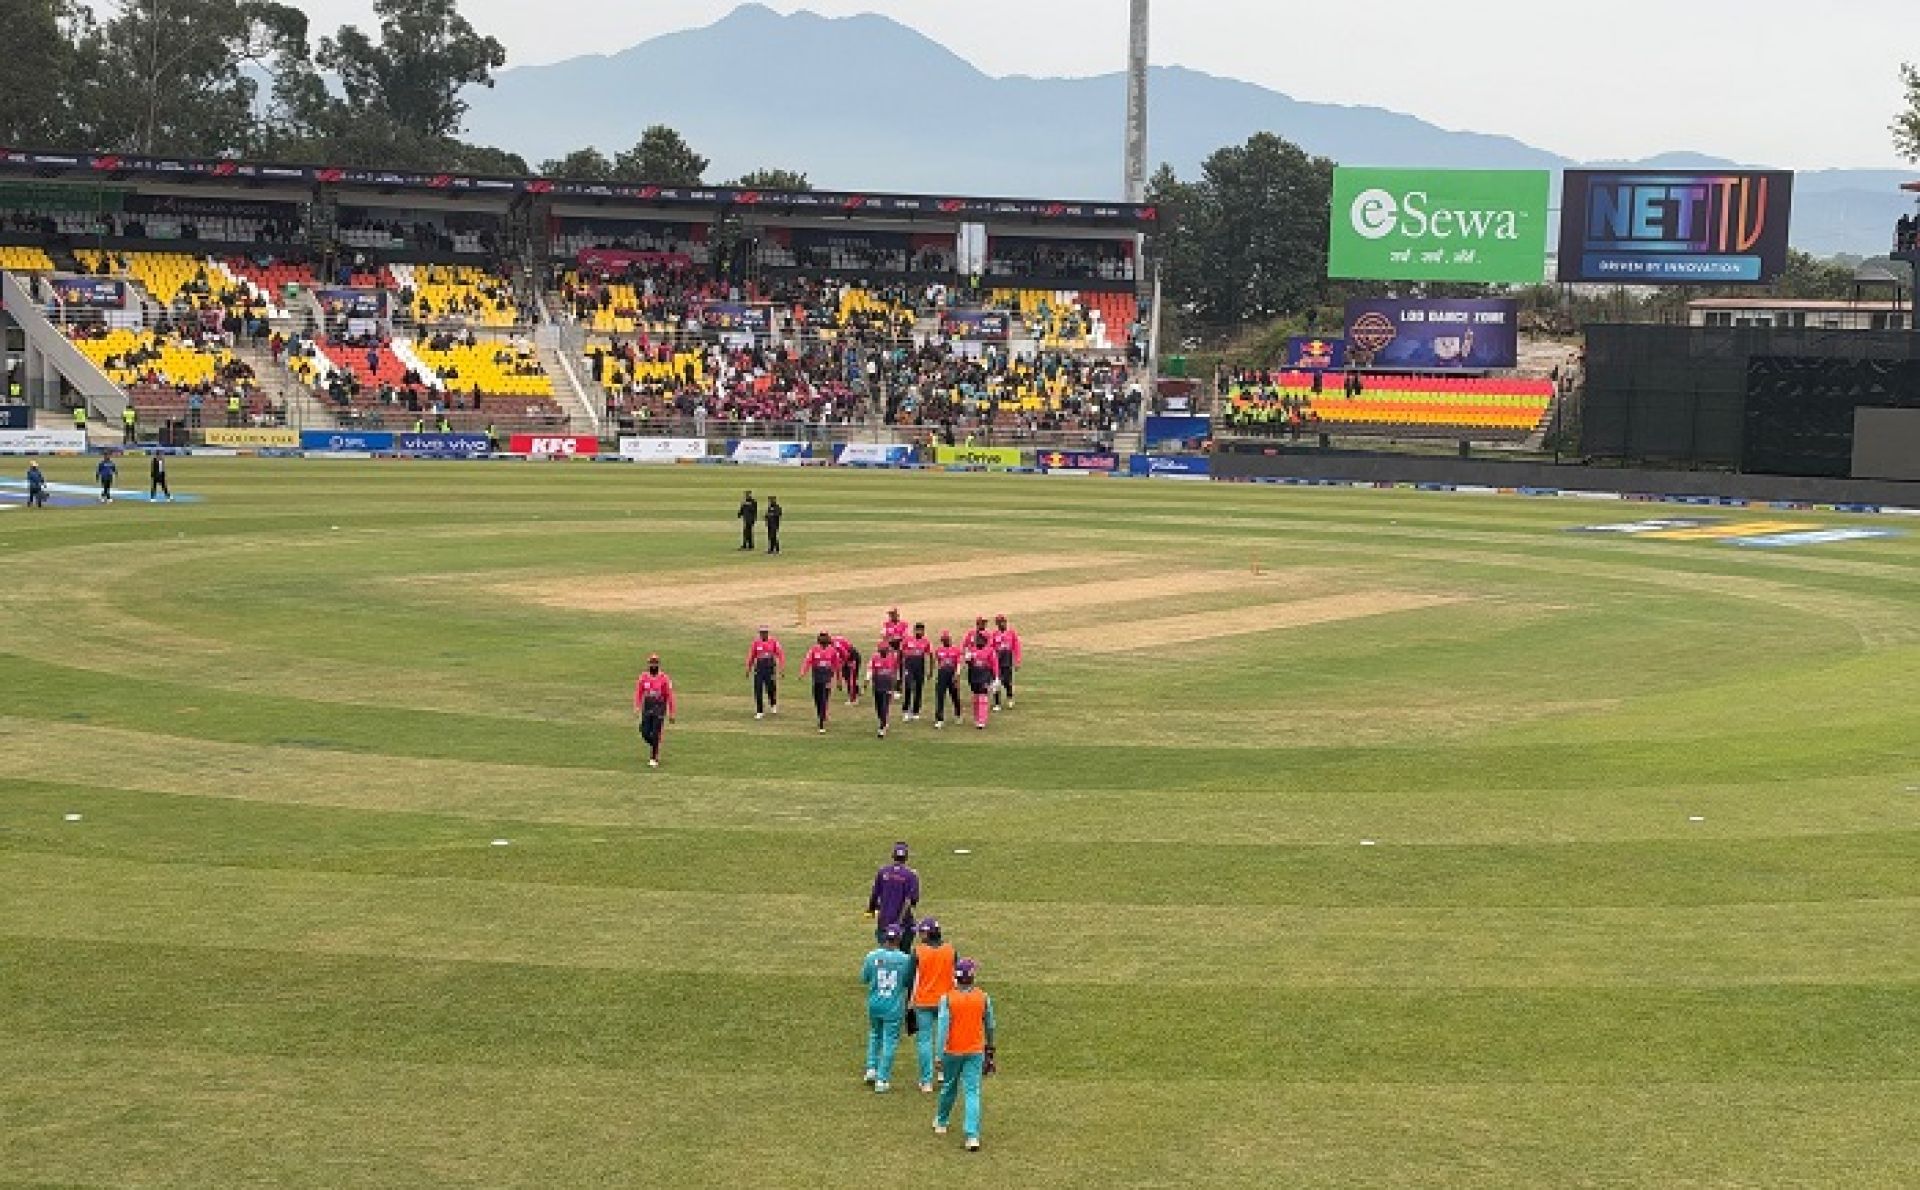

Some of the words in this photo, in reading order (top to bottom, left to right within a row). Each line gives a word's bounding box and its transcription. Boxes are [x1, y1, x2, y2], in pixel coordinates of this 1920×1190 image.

[1351, 189, 1519, 239] eSewa
[1599, 260, 1643, 272] DRIVEN
[1646, 262, 1662, 272] BY
[1665, 262, 1741, 273] INNOVATION
[531, 438, 577, 453] KFC
